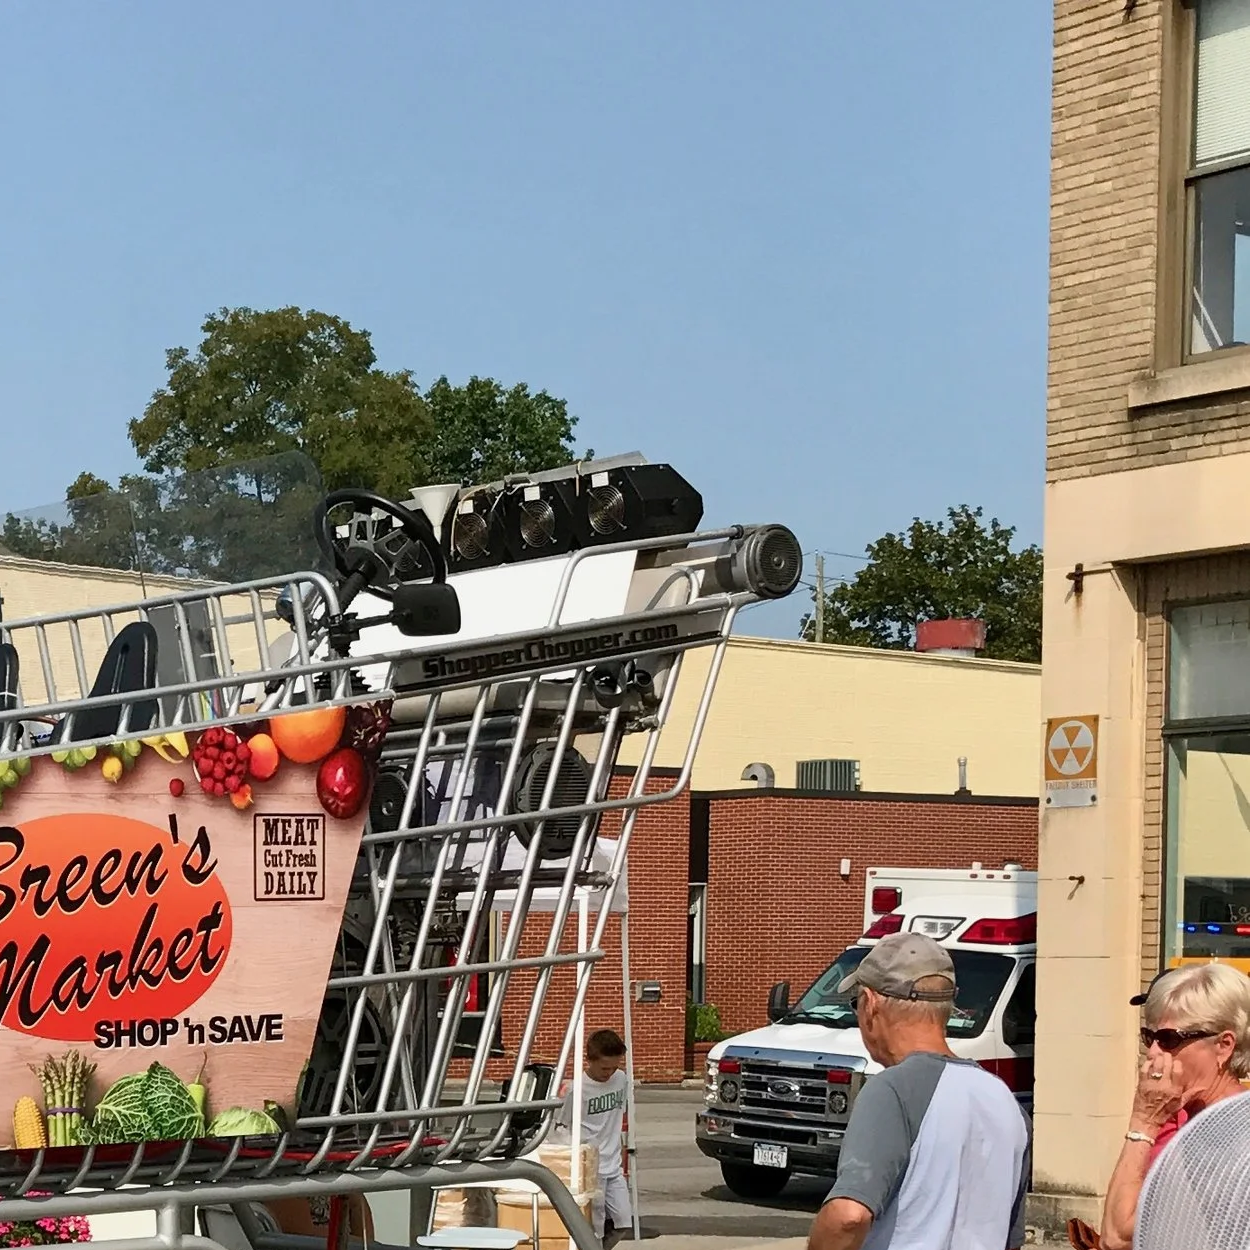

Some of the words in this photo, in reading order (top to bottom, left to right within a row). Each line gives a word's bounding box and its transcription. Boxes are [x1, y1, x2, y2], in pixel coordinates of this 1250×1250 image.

[422, 623, 678, 678] ShopperChopper.com
[262, 818, 320, 846] MEAT
[264, 849, 283, 868] Cut
[285, 849, 317, 868] Fresh
[264, 871, 318, 895] DAILY
[94, 1018, 180, 1049] SHOP
[184, 1017, 205, 1045] 'n
[208, 1014, 284, 1043] SAVE
